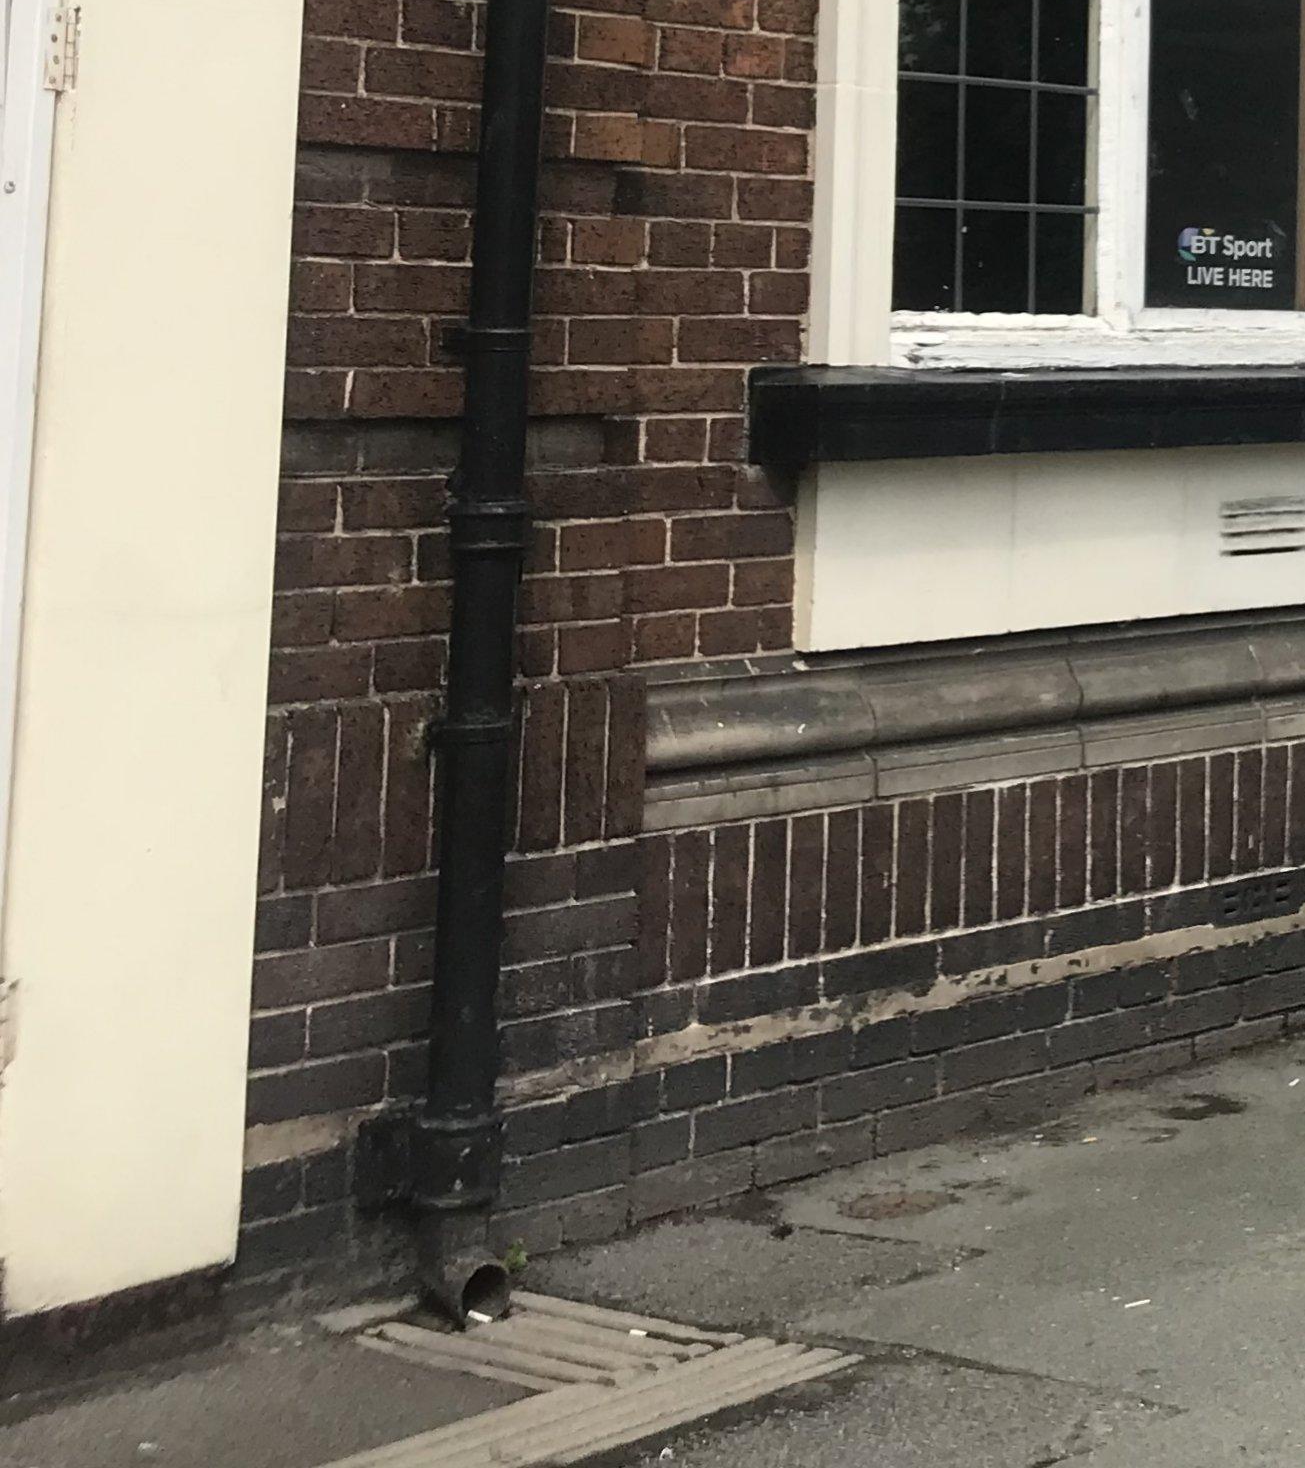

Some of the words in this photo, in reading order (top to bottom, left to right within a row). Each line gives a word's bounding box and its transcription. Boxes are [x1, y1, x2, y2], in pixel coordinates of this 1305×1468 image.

[1190, 235, 1222, 256] BT
[1222, 234, 1273, 260] Sport
[1186, 265, 1224, 287] LIVE
[1228, 267, 1274, 289] HERE
